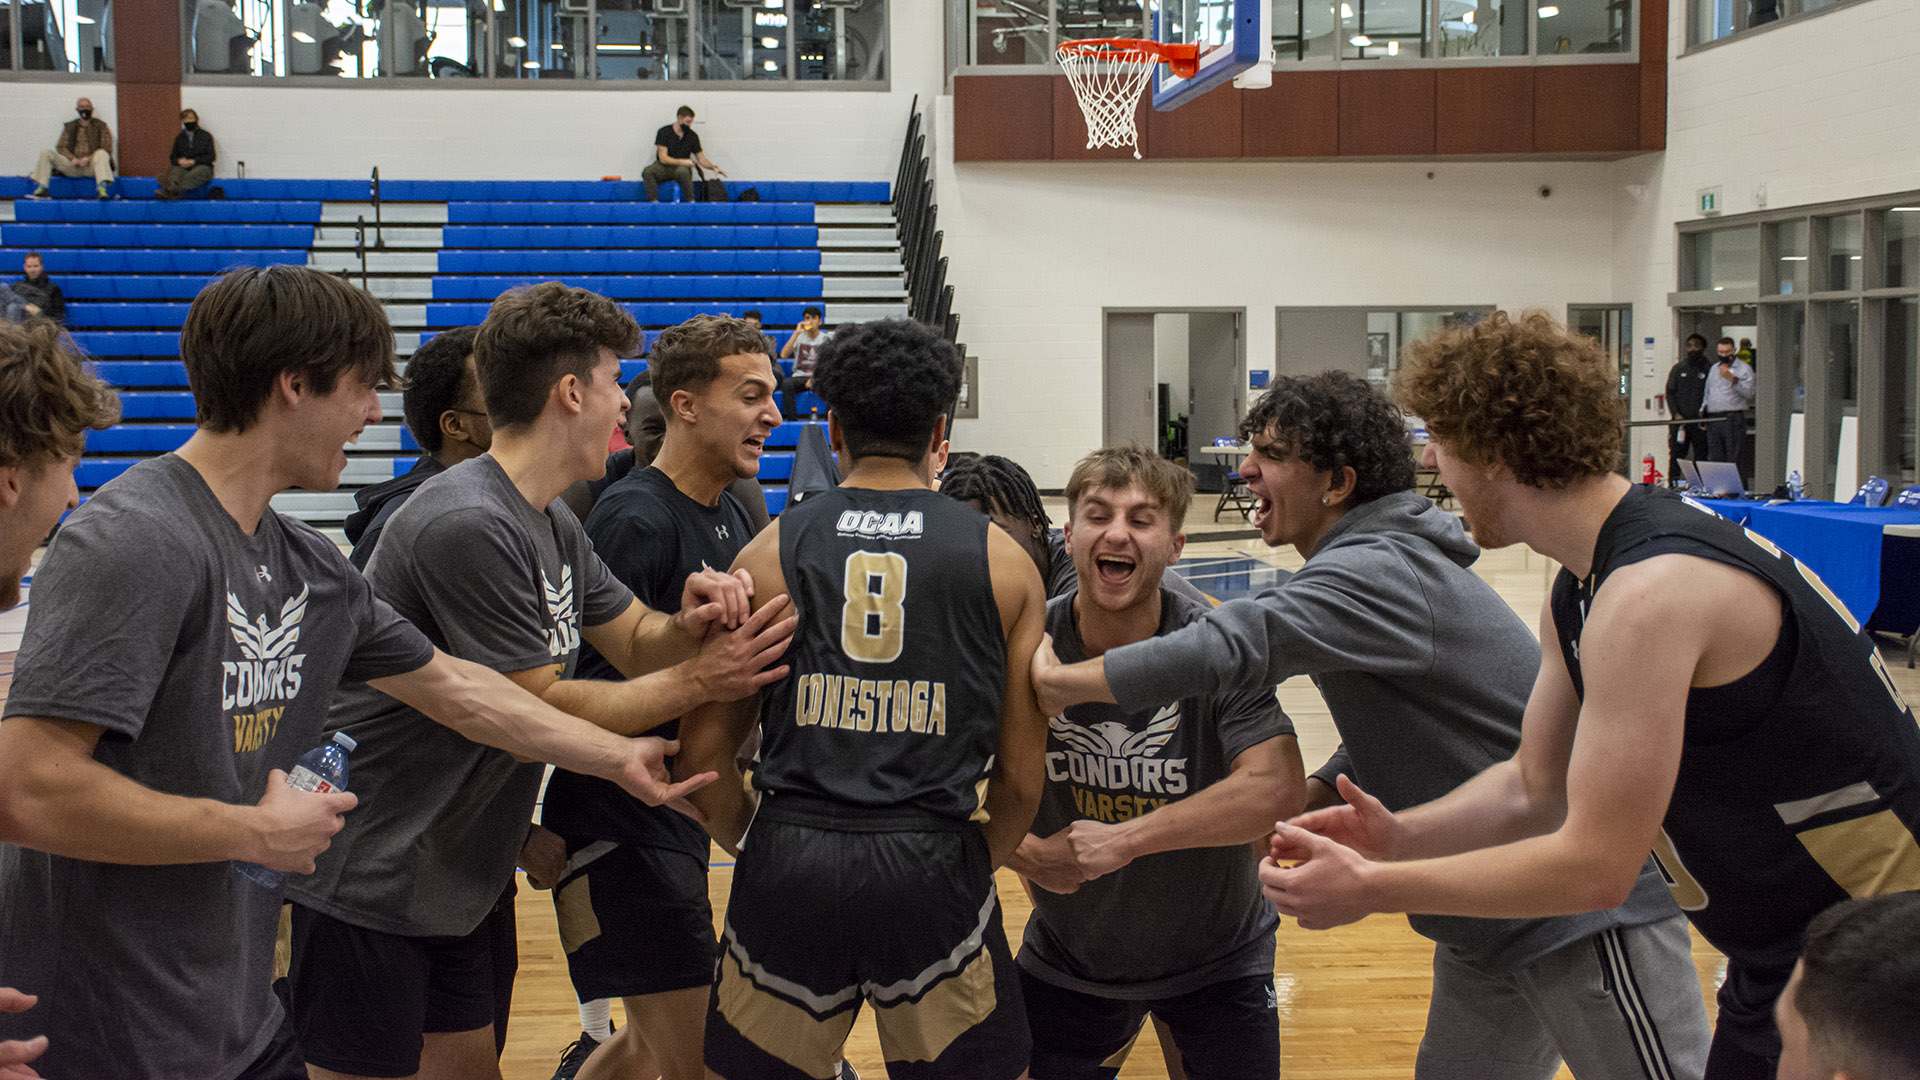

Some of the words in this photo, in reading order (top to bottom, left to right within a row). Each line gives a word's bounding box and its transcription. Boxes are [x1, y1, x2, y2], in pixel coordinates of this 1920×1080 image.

[836, 510, 923, 535] OCAA
[841, 550, 908, 663] 8
[222, 654, 307, 711] COORS
[796, 673, 946, 736] CONESTOGA
[1045, 750, 1188, 794] CONDORS
[1070, 785, 1168, 823] VARSTY
